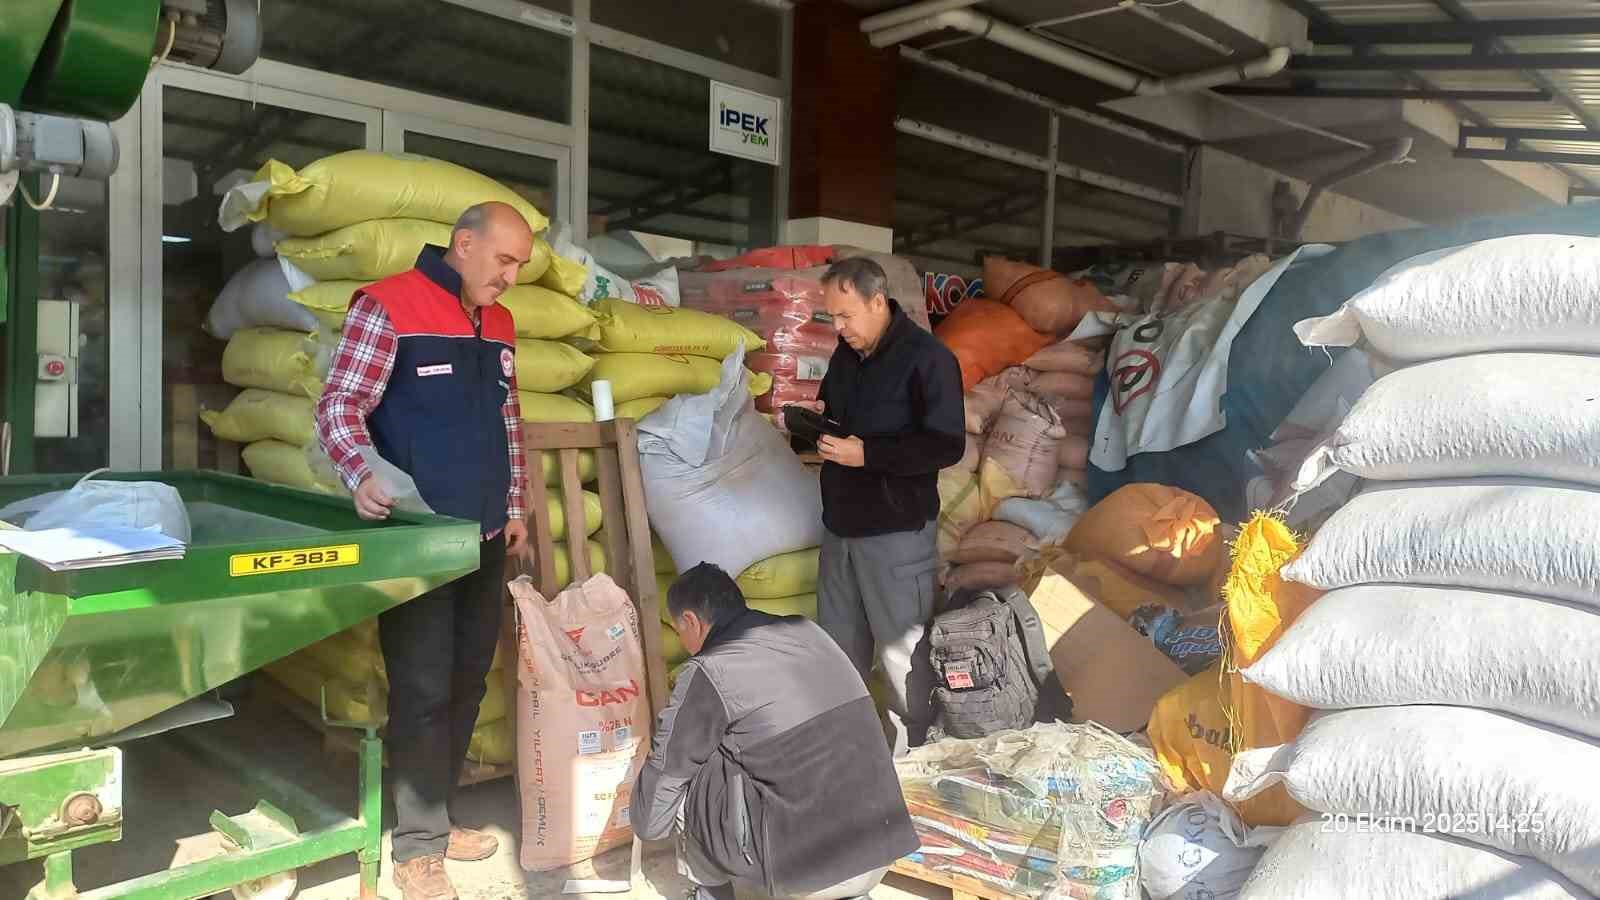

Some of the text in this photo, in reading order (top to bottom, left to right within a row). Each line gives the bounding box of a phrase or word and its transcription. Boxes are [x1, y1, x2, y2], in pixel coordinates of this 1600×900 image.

[742, 132, 769, 147] YEM
[253, 551, 338, 569] KF-383
[576, 679, 640, 707] CAN
